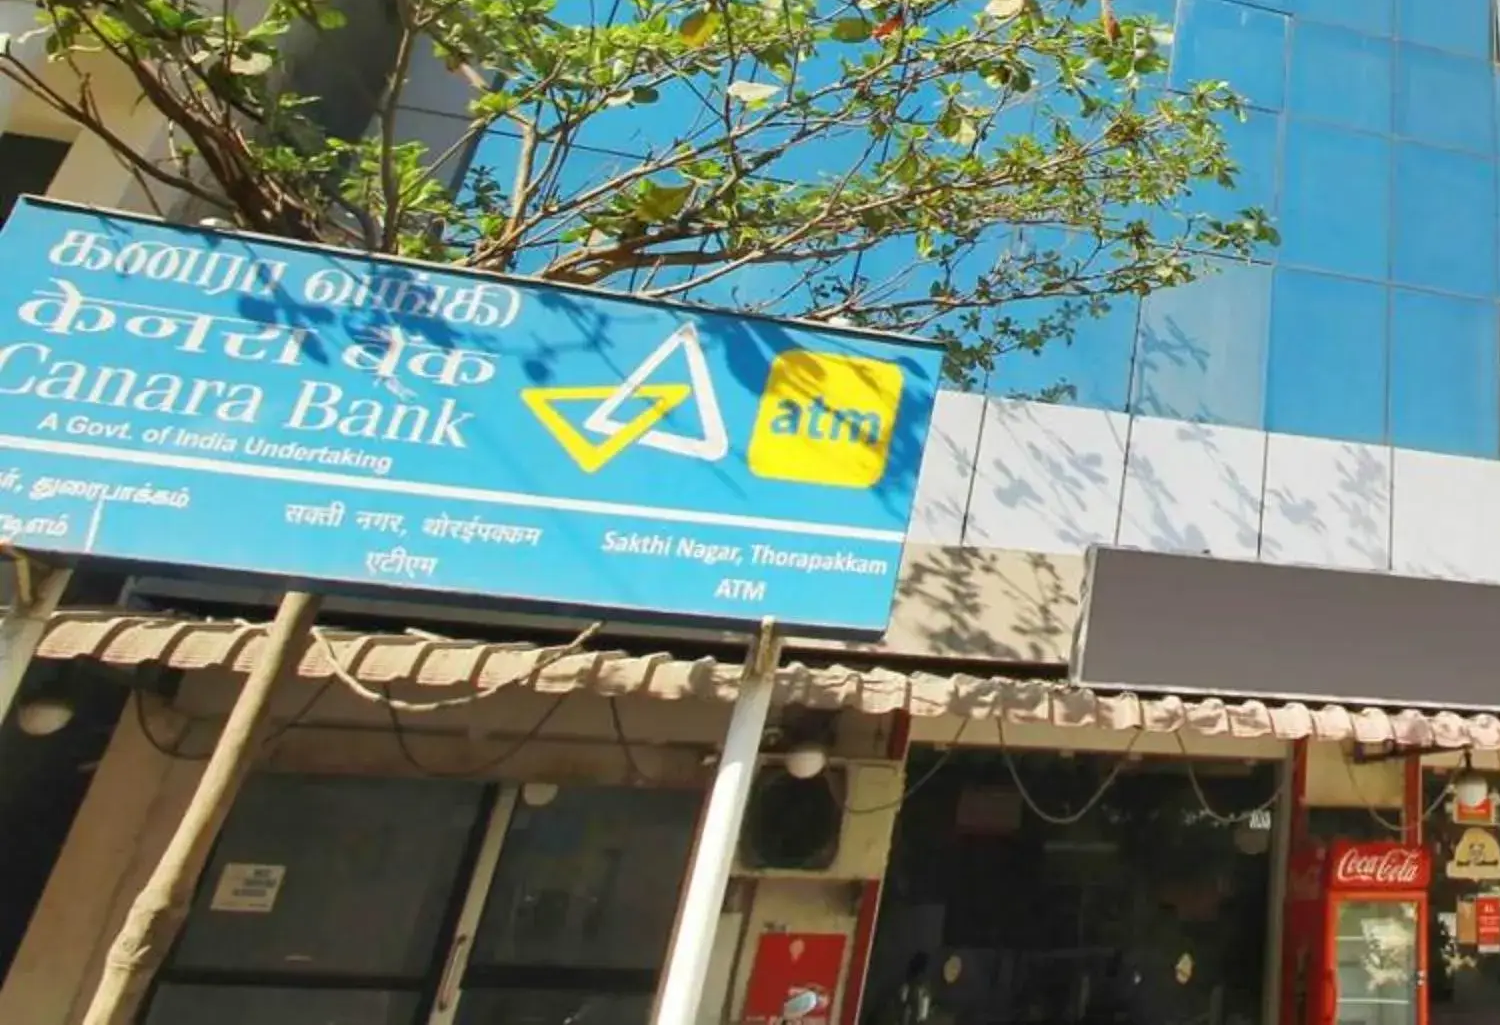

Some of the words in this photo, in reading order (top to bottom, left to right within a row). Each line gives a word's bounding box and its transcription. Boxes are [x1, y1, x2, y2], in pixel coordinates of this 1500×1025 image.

[48, 228, 287, 295] கனரா
[18, 278, 320, 366] केनरा
[0, 342, 264, 424] Canara
[283, 380, 475, 449] Bank
[769, 392, 882, 446] atm
[36, 411, 58, 431] A
[66, 415, 133, 441] Govt.
[142, 426, 170, 445] of
[174, 428, 238, 454] India
[245, 438, 392, 474] Undertaking
[601, 529, 673, 556] Sakthi
[677, 538, 743, 568] Nagar,
[750, 544, 887, 576] Thorapakkam
[715, 577, 766, 602] ATM
